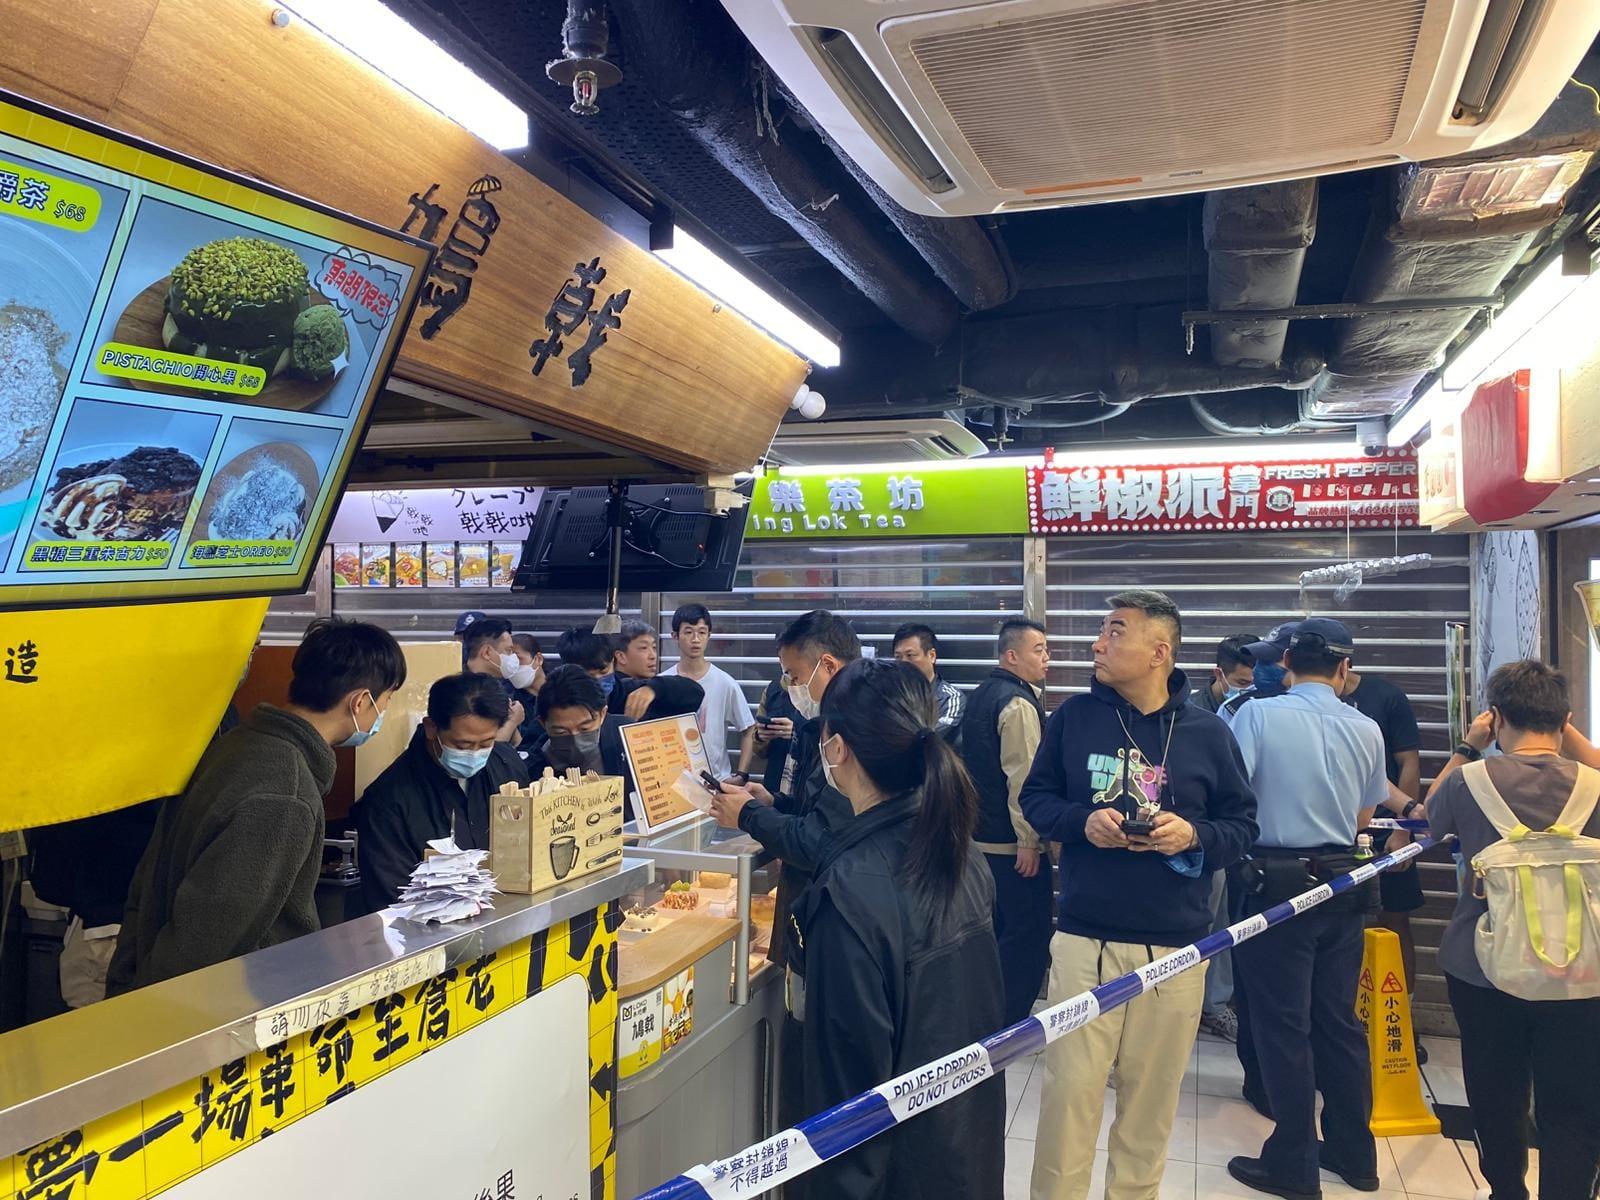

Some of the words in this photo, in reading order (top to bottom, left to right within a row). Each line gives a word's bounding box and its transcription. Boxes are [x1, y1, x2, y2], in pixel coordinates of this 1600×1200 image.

[53, 199, 87, 222] $68
[323, 258, 392, 318] 期間限定
[101, 350, 237, 385] PISTACHIO開心果
[1263, 464, 1331, 480] FRESH
[1333, 461, 1417, 478] PEPPER
[452, 486, 535, 508] クレープ
[768, 476, 924, 513] 樂茶坊
[803, 512, 847, 531] Lok
[859, 513, 906, 530] Tea
[30, 545, 146, 562] 黑糖三重朱古力
[5, 640, 39, 683] 造
[553, 795, 581, 809] KITCHEN
[1145, 961, 1169, 983] POLICE
[1385, 996, 1402, 1052] 小心地滑
[893, 1070, 935, 1098] POLICE
[908, 1092, 925, 1111] DO
[926, 1080, 949, 1103] NOT
[952, 1063, 986, 1090] CROSS
[474, 1169, 515, 1200] 果
[730, 1152, 788, 1192] 不得越過
